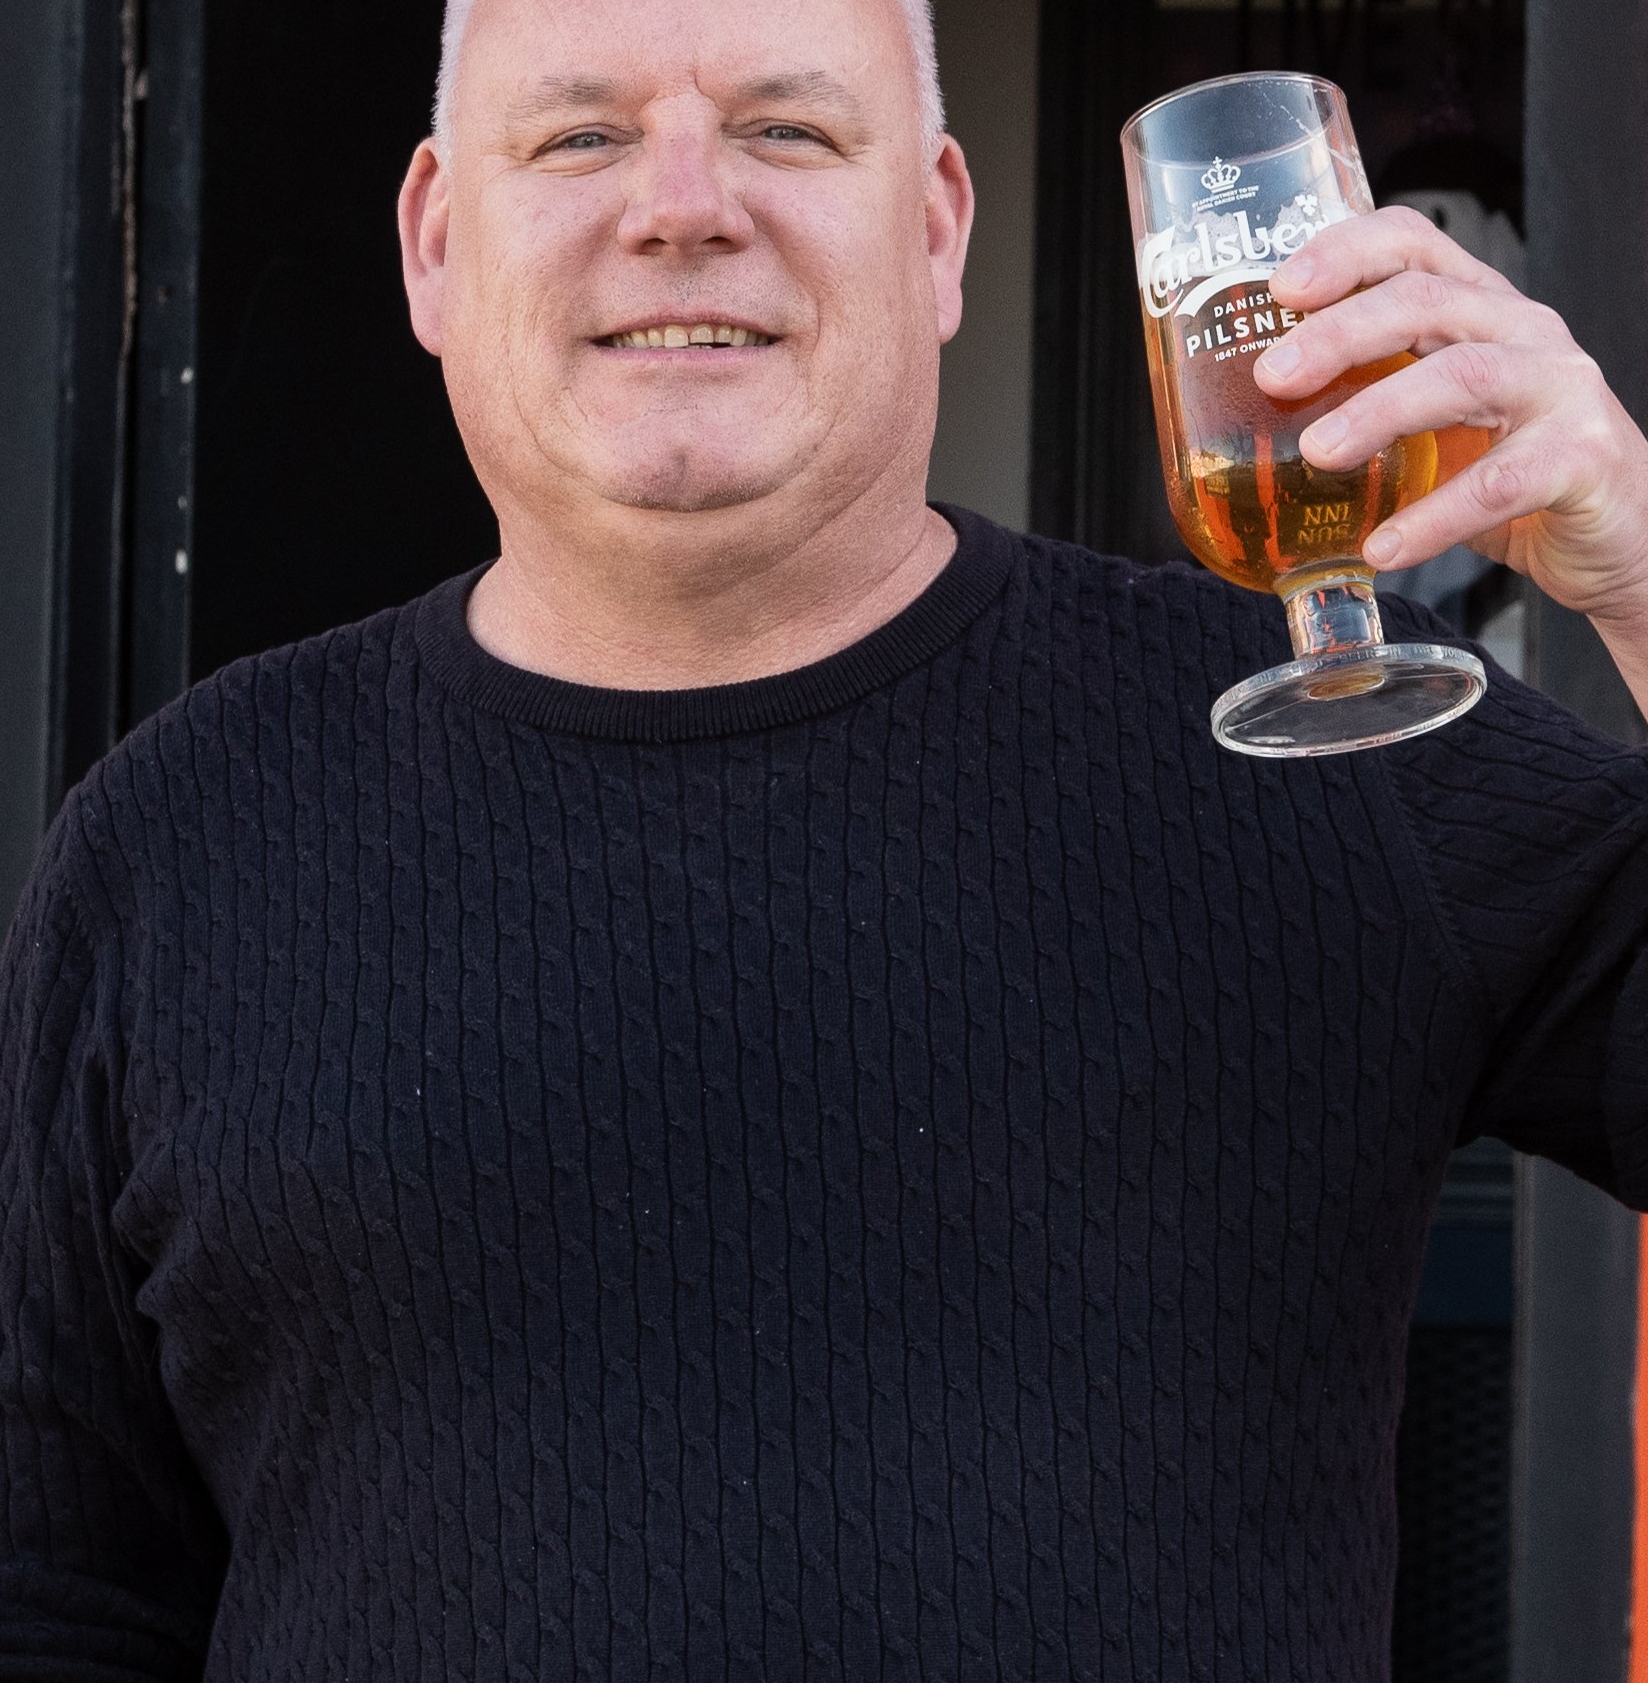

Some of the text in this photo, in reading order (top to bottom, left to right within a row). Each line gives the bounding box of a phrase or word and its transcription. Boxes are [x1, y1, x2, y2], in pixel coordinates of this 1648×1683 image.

[1142, 210, 1329, 318] Carlsber
[1186, 308, 1303, 358] PILSNE
[1214, 336, 1281, 362] 1847 ONWA
